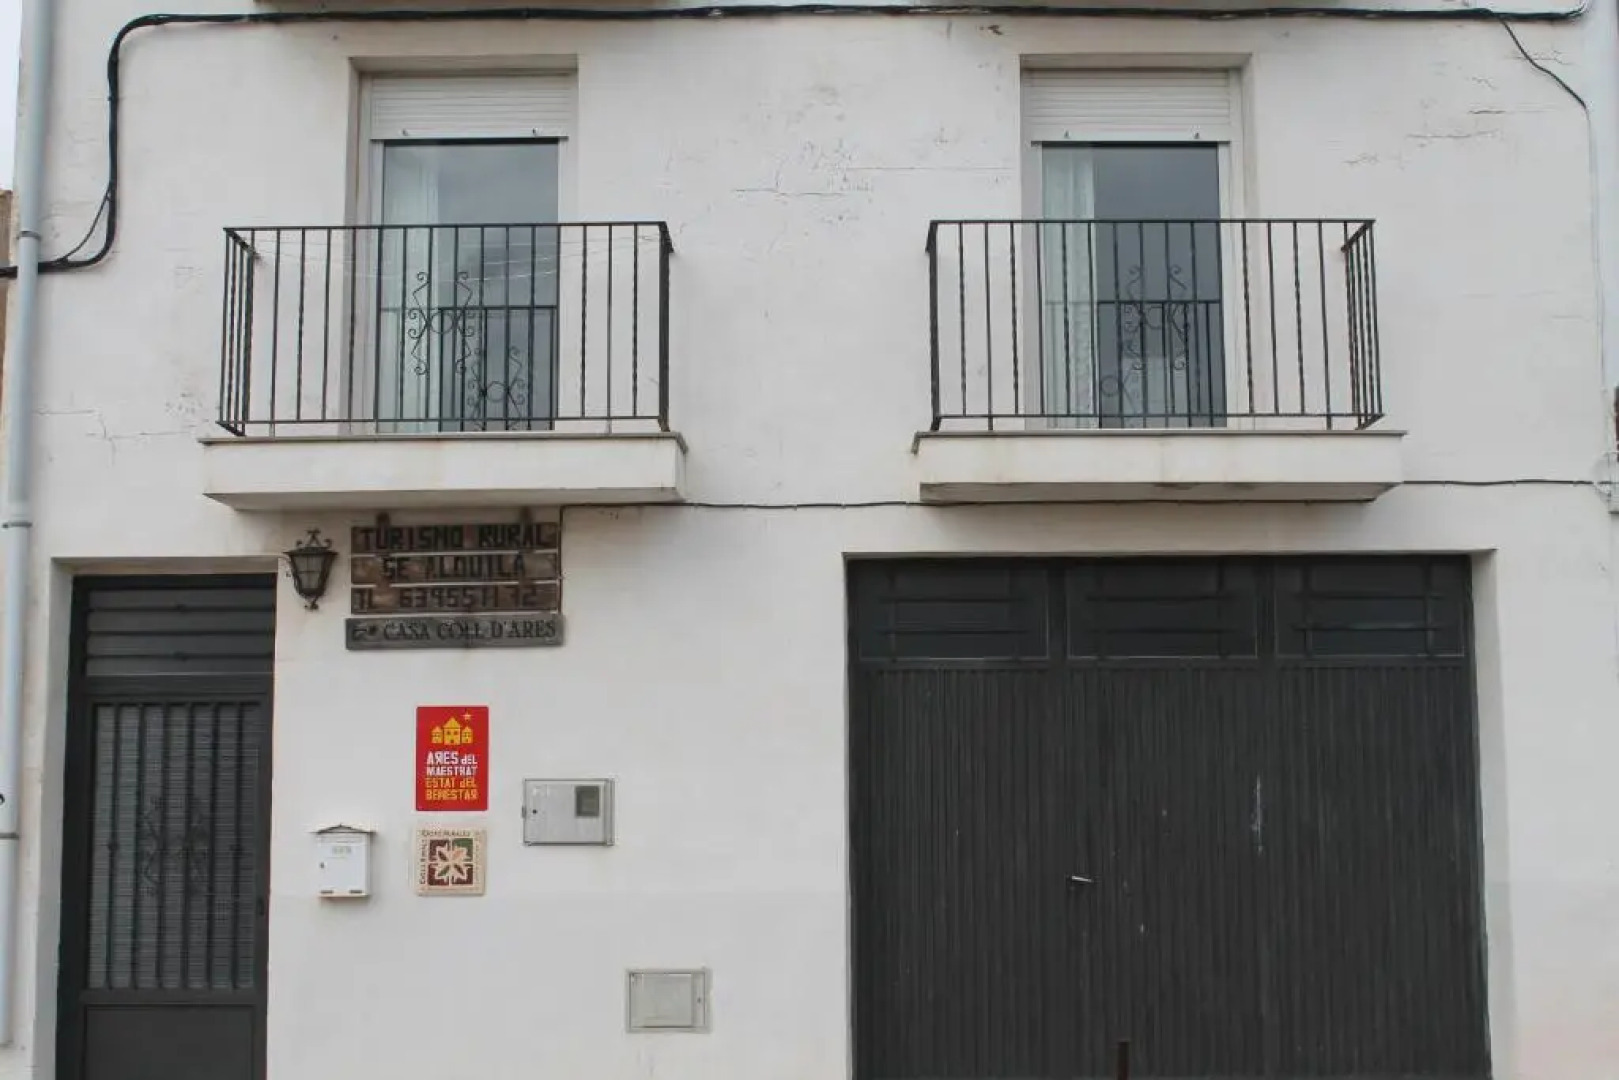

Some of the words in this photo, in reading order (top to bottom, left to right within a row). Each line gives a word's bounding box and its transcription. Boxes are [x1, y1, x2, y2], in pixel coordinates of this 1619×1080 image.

[359, 526, 463, 549] TURISMO
[478, 523, 550, 548] RURAL
[382, 555, 410, 580] SE
[425, 554, 526, 578] ALQUILA
[383, 621, 431, 641] CASA
[436, 620, 485, 641] COLL
[491, 618, 557, 640] D'ARES
[427, 750, 460, 764] ARES
[426, 765, 478, 776] MAESTRAT
[426, 777, 455, 788] ESTAT
[426, 789, 478, 801] BENESTAR
